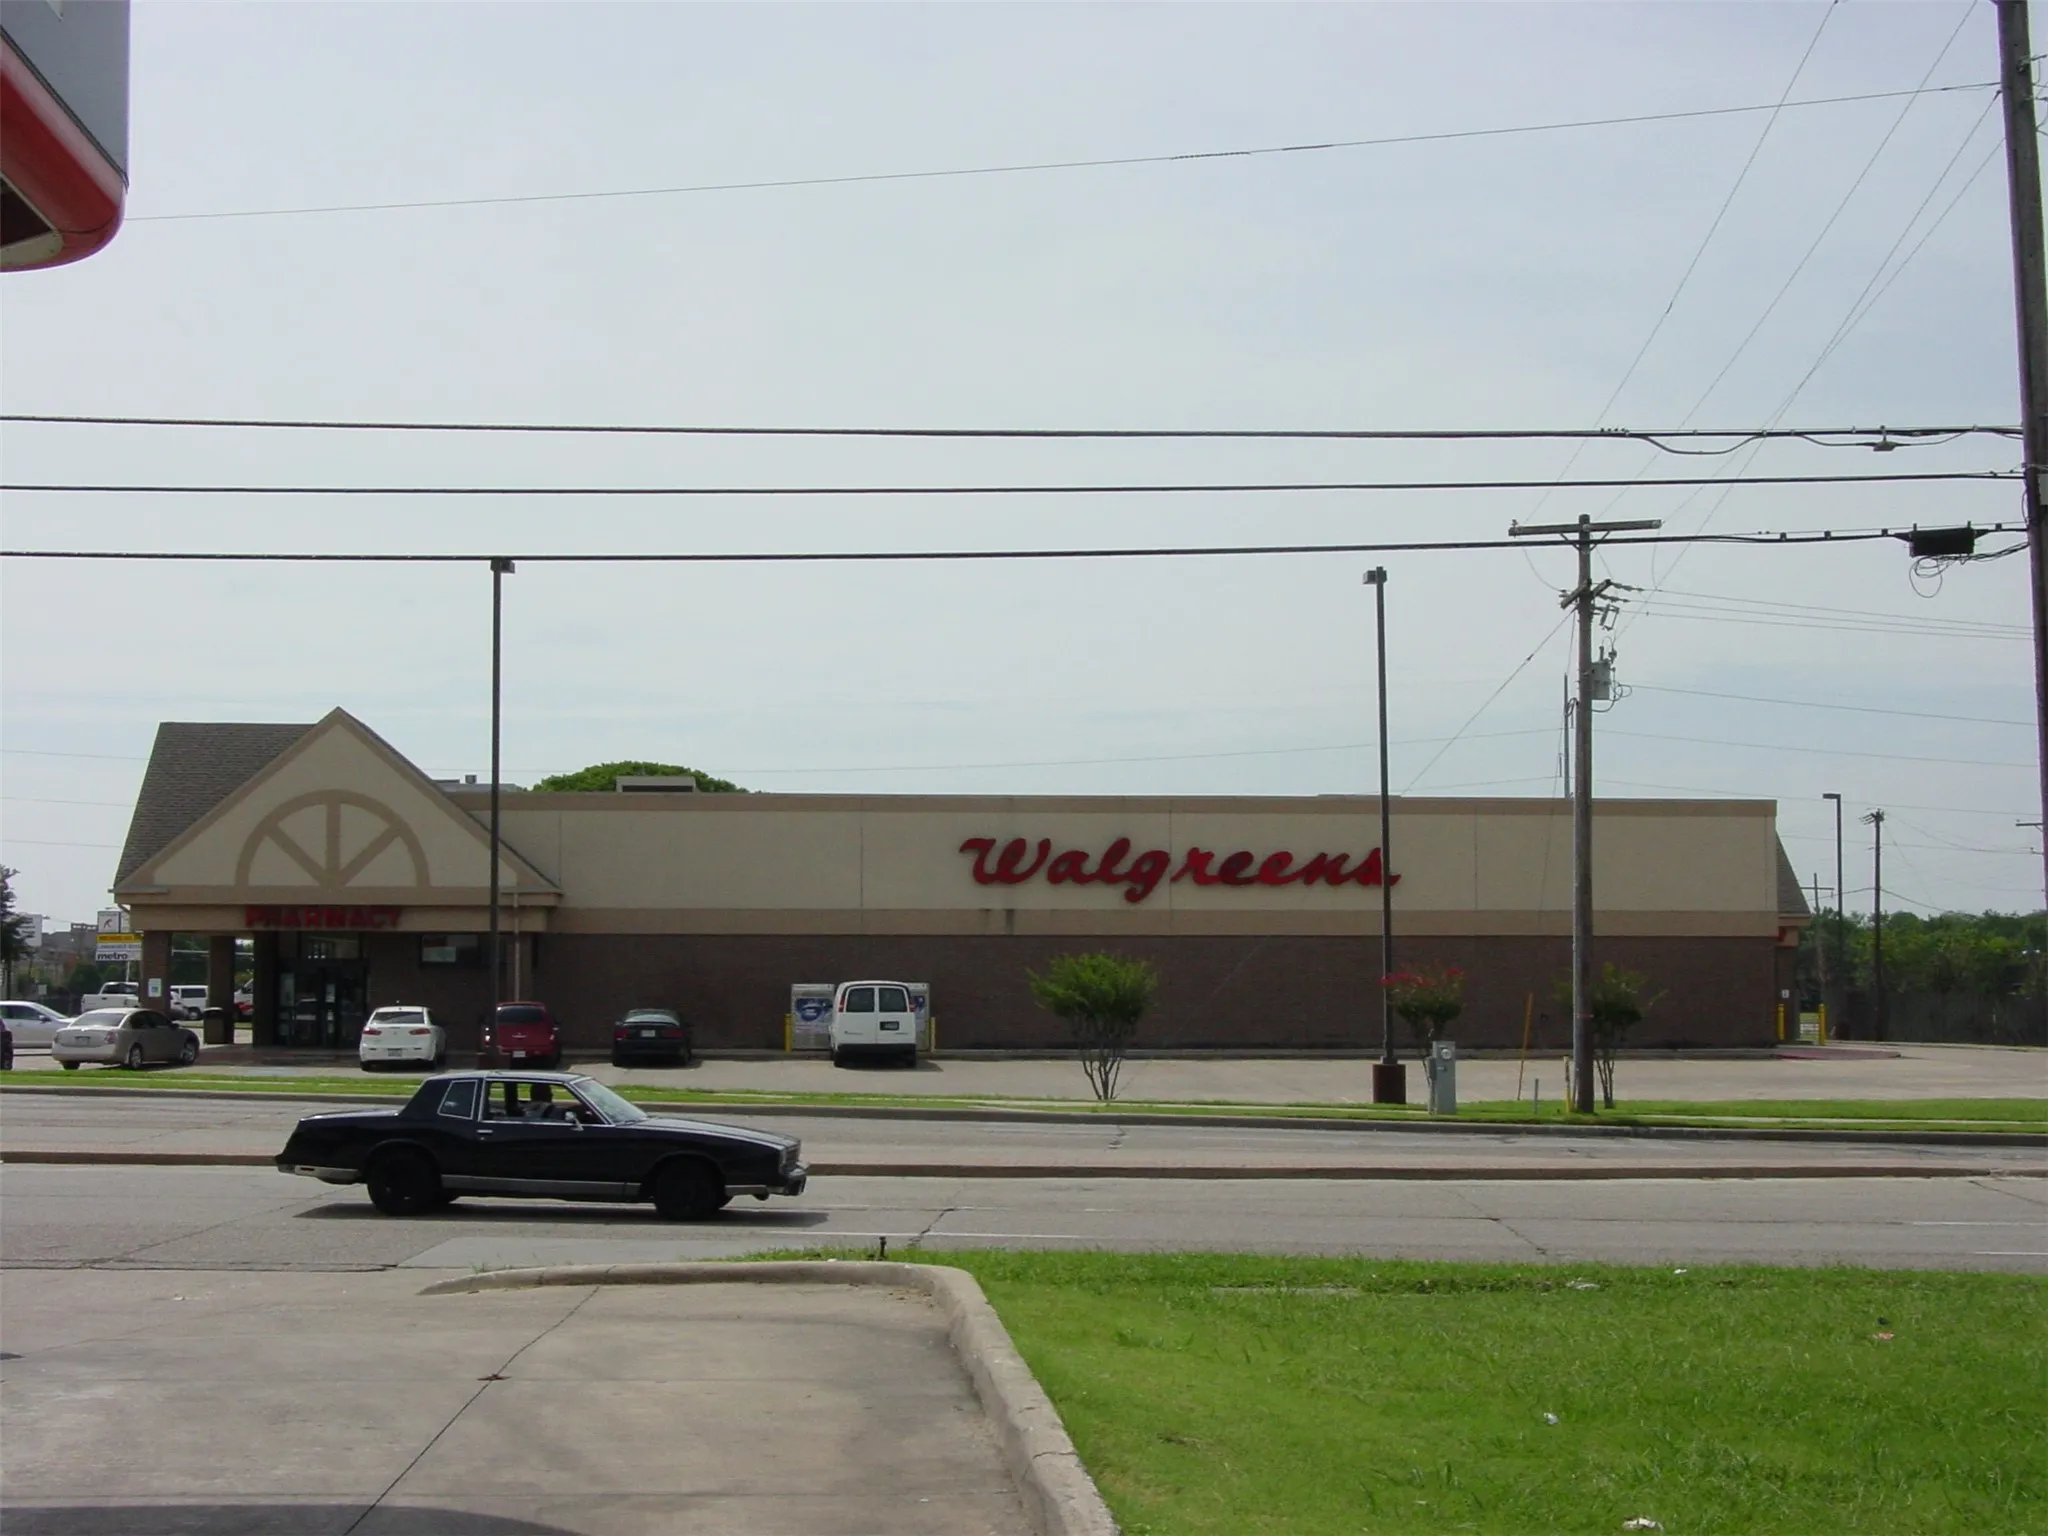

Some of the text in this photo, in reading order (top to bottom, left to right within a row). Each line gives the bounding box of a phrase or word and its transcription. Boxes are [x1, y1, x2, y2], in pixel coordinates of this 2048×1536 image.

[959, 837, 1402, 904] Walgreens
[245, 905, 402, 929] PHARMACY
[97, 952, 129, 960] metro
